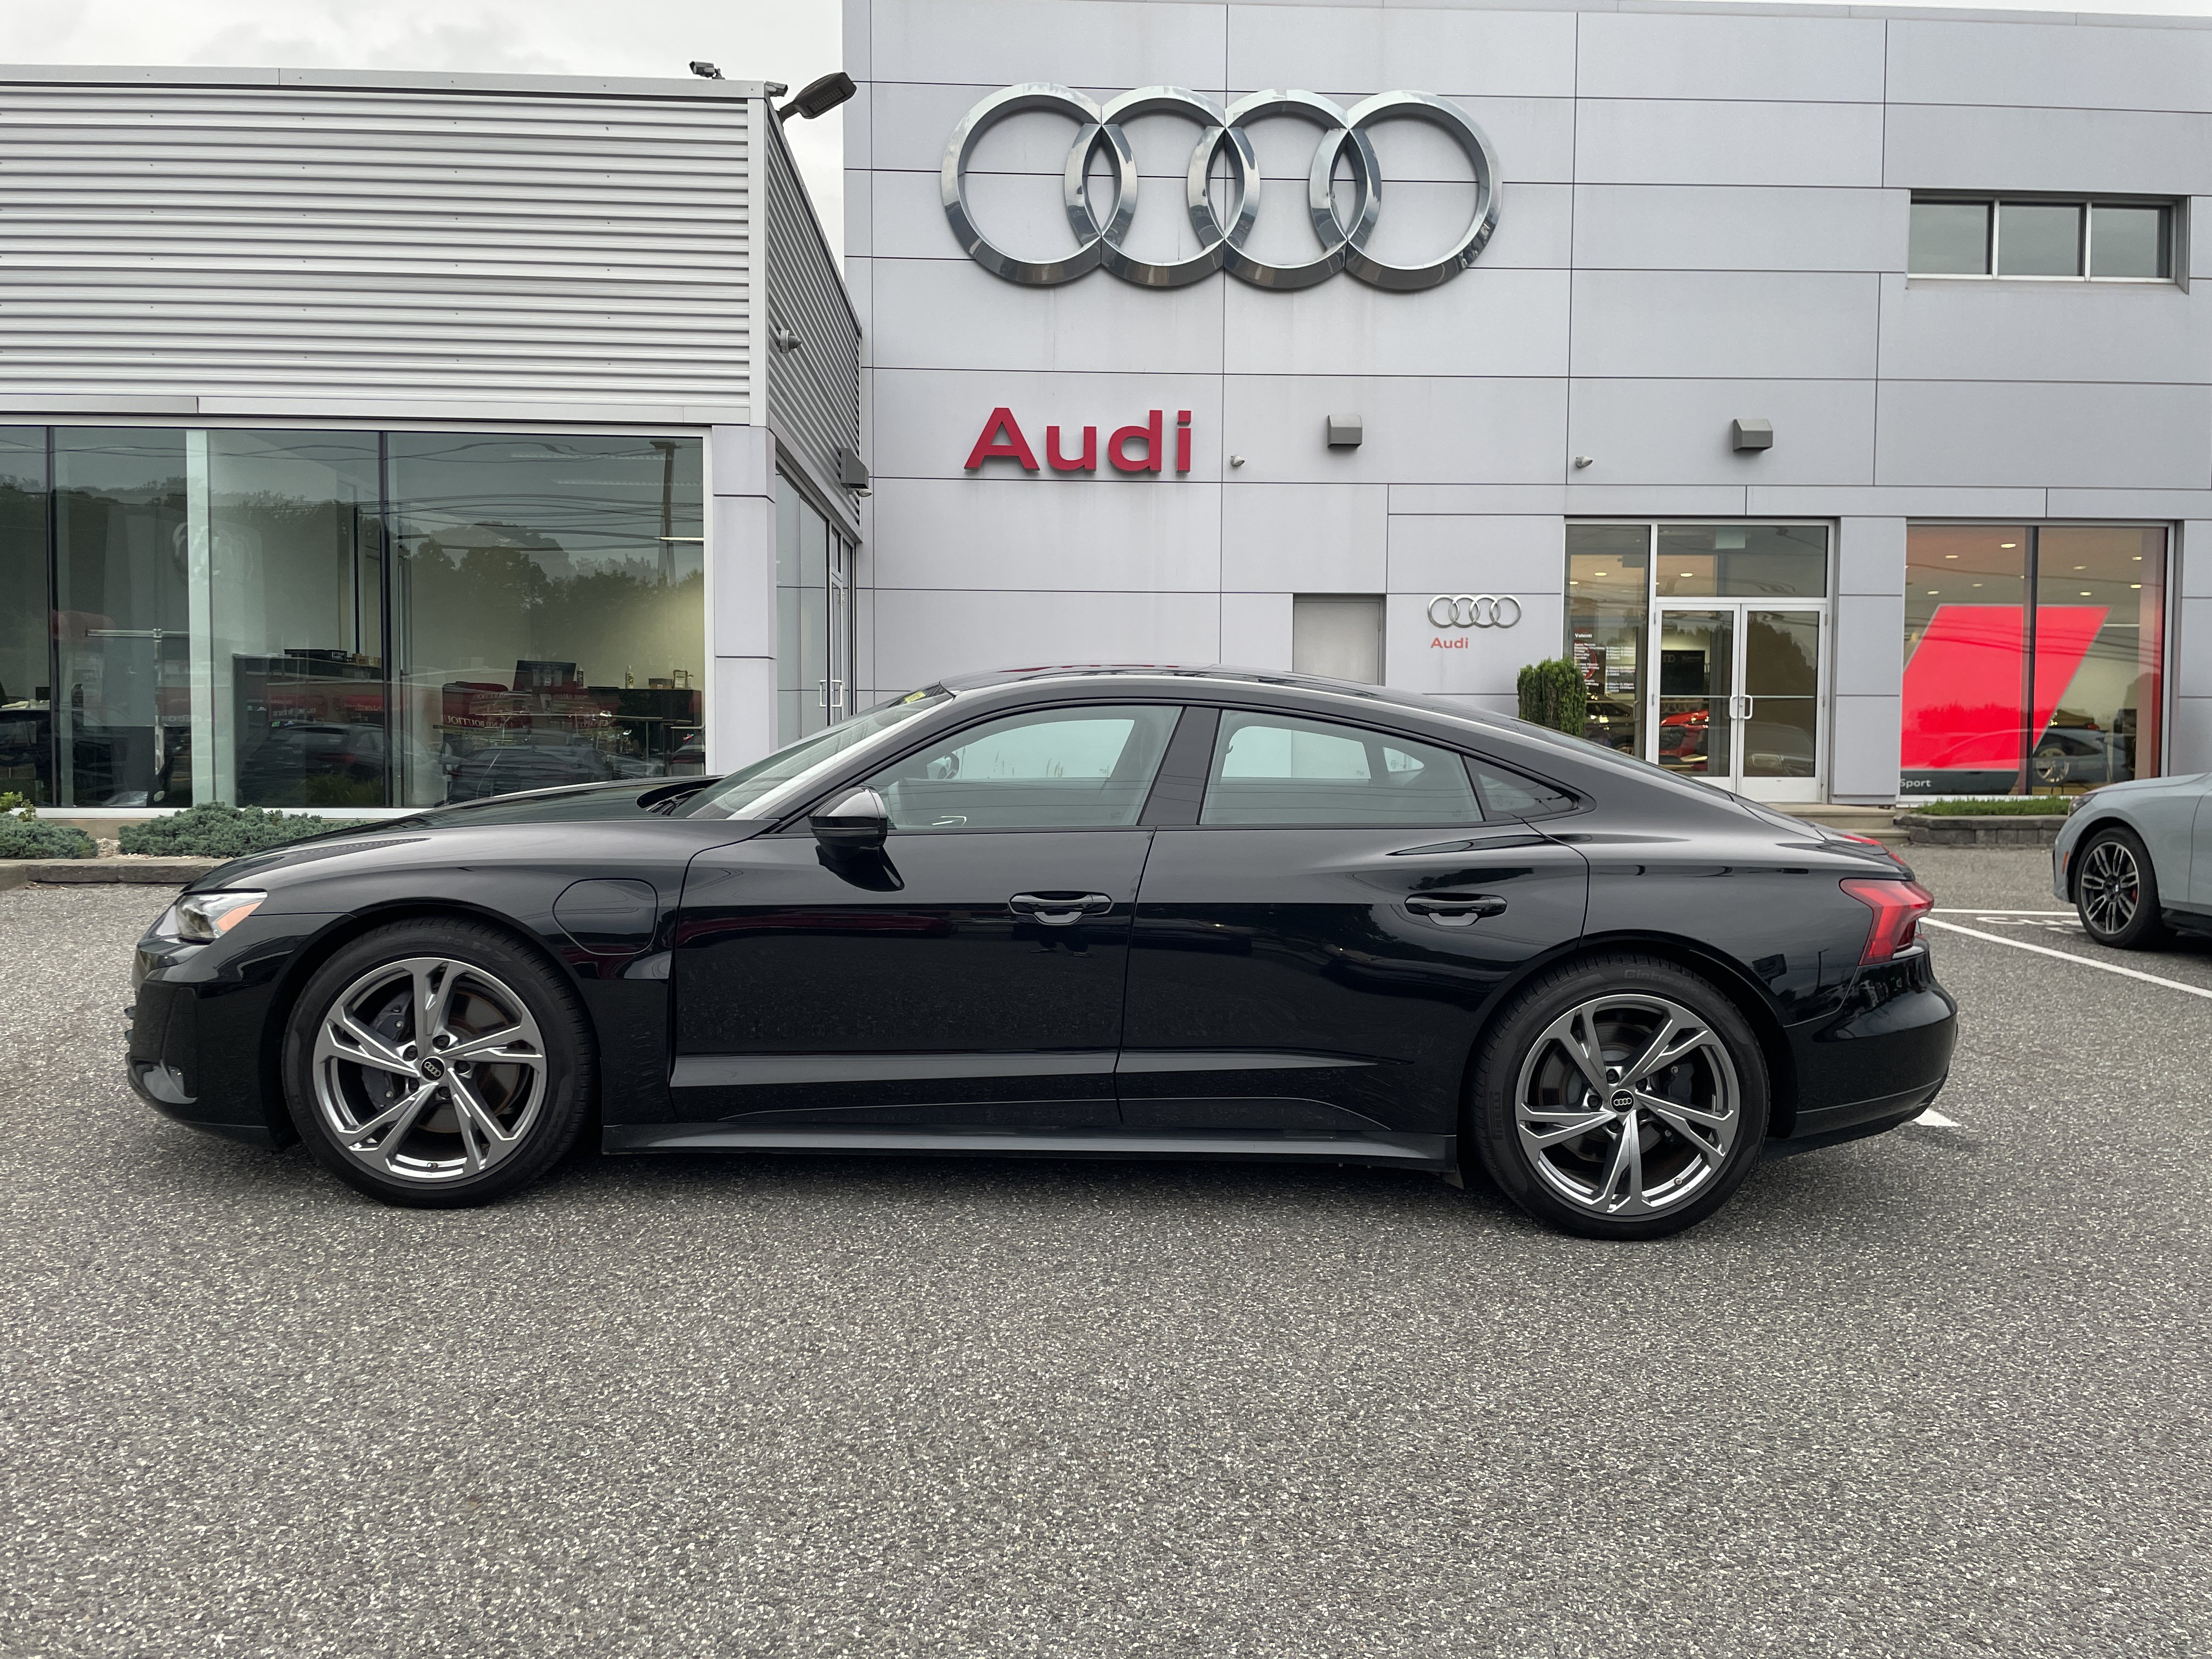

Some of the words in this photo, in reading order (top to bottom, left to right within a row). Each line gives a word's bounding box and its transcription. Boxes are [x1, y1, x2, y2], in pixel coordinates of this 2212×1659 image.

[964, 408, 1192, 473] Audi
[1430, 636, 1469, 649] Audi
[1900, 778, 1932, 789] Sport
[1489, 1092, 1503, 1139] PIRELLI
